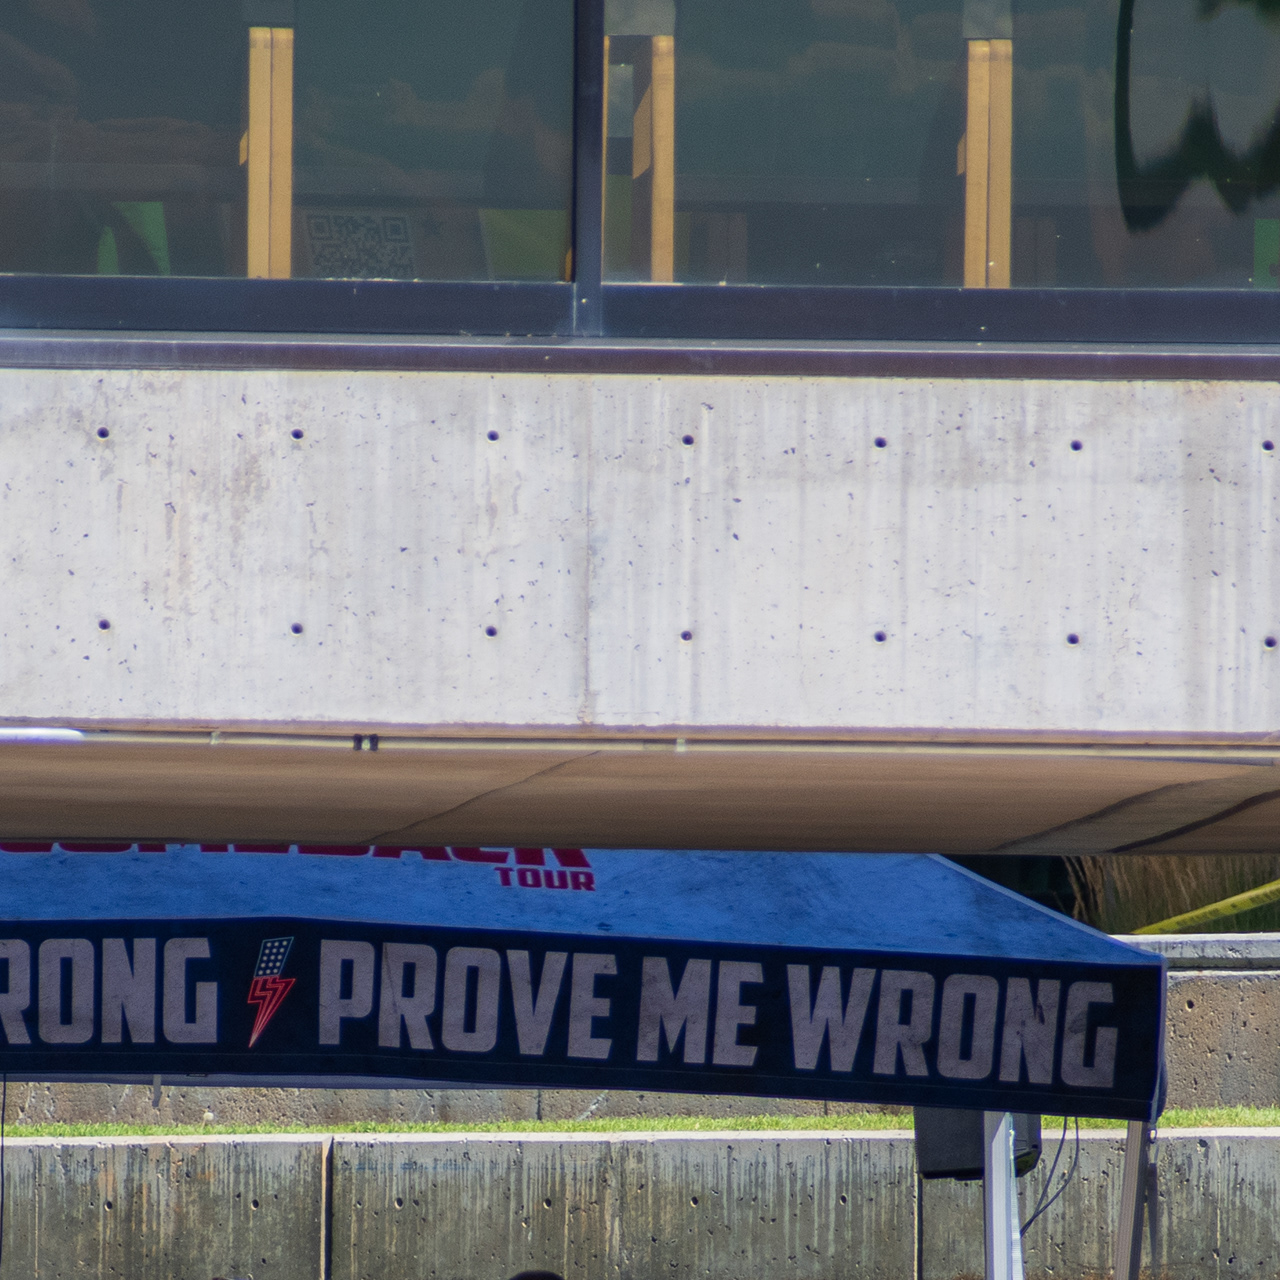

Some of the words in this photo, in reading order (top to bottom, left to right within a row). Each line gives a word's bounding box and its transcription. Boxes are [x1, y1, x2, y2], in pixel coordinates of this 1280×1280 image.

[494, 867, 597, 892] TOUR
[318, 939, 618, 1060] PROVE
[636, 956, 764, 1068] ME
[786, 964, 1118, 1089] WRONG
